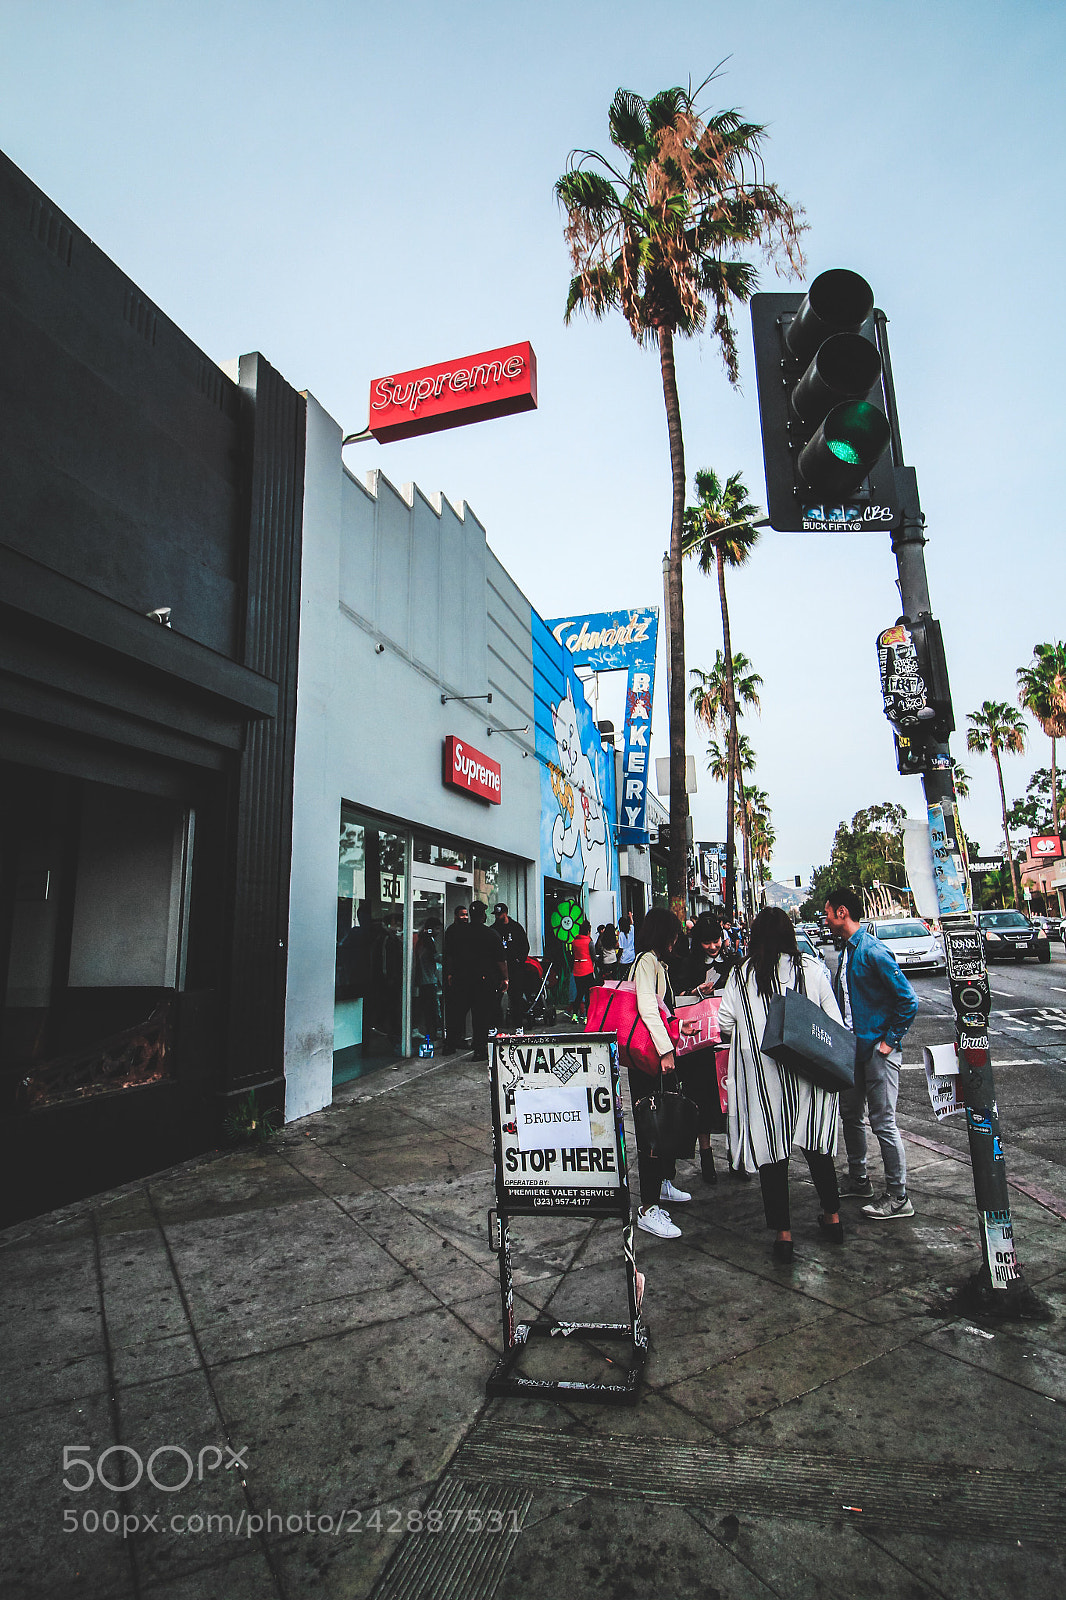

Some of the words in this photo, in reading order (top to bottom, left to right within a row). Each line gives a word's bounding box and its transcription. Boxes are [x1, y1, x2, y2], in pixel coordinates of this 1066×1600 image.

[372, 355, 524, 411] Supreme
[803, 522, 828, 530] BUCK
[552, 613, 650, 654] Schwartz
[625, 672, 650, 828] BAKERY
[454, 743, 501, 792] Supreme
[523, 1111, 582, 1125] BRUNCH
[505, 1147, 557, 1172] STOP
[562, 1147, 616, 1172] HERE
[533, 1198, 554, 1206] (323)
[580, 1189, 615, 1197] SERVICE
